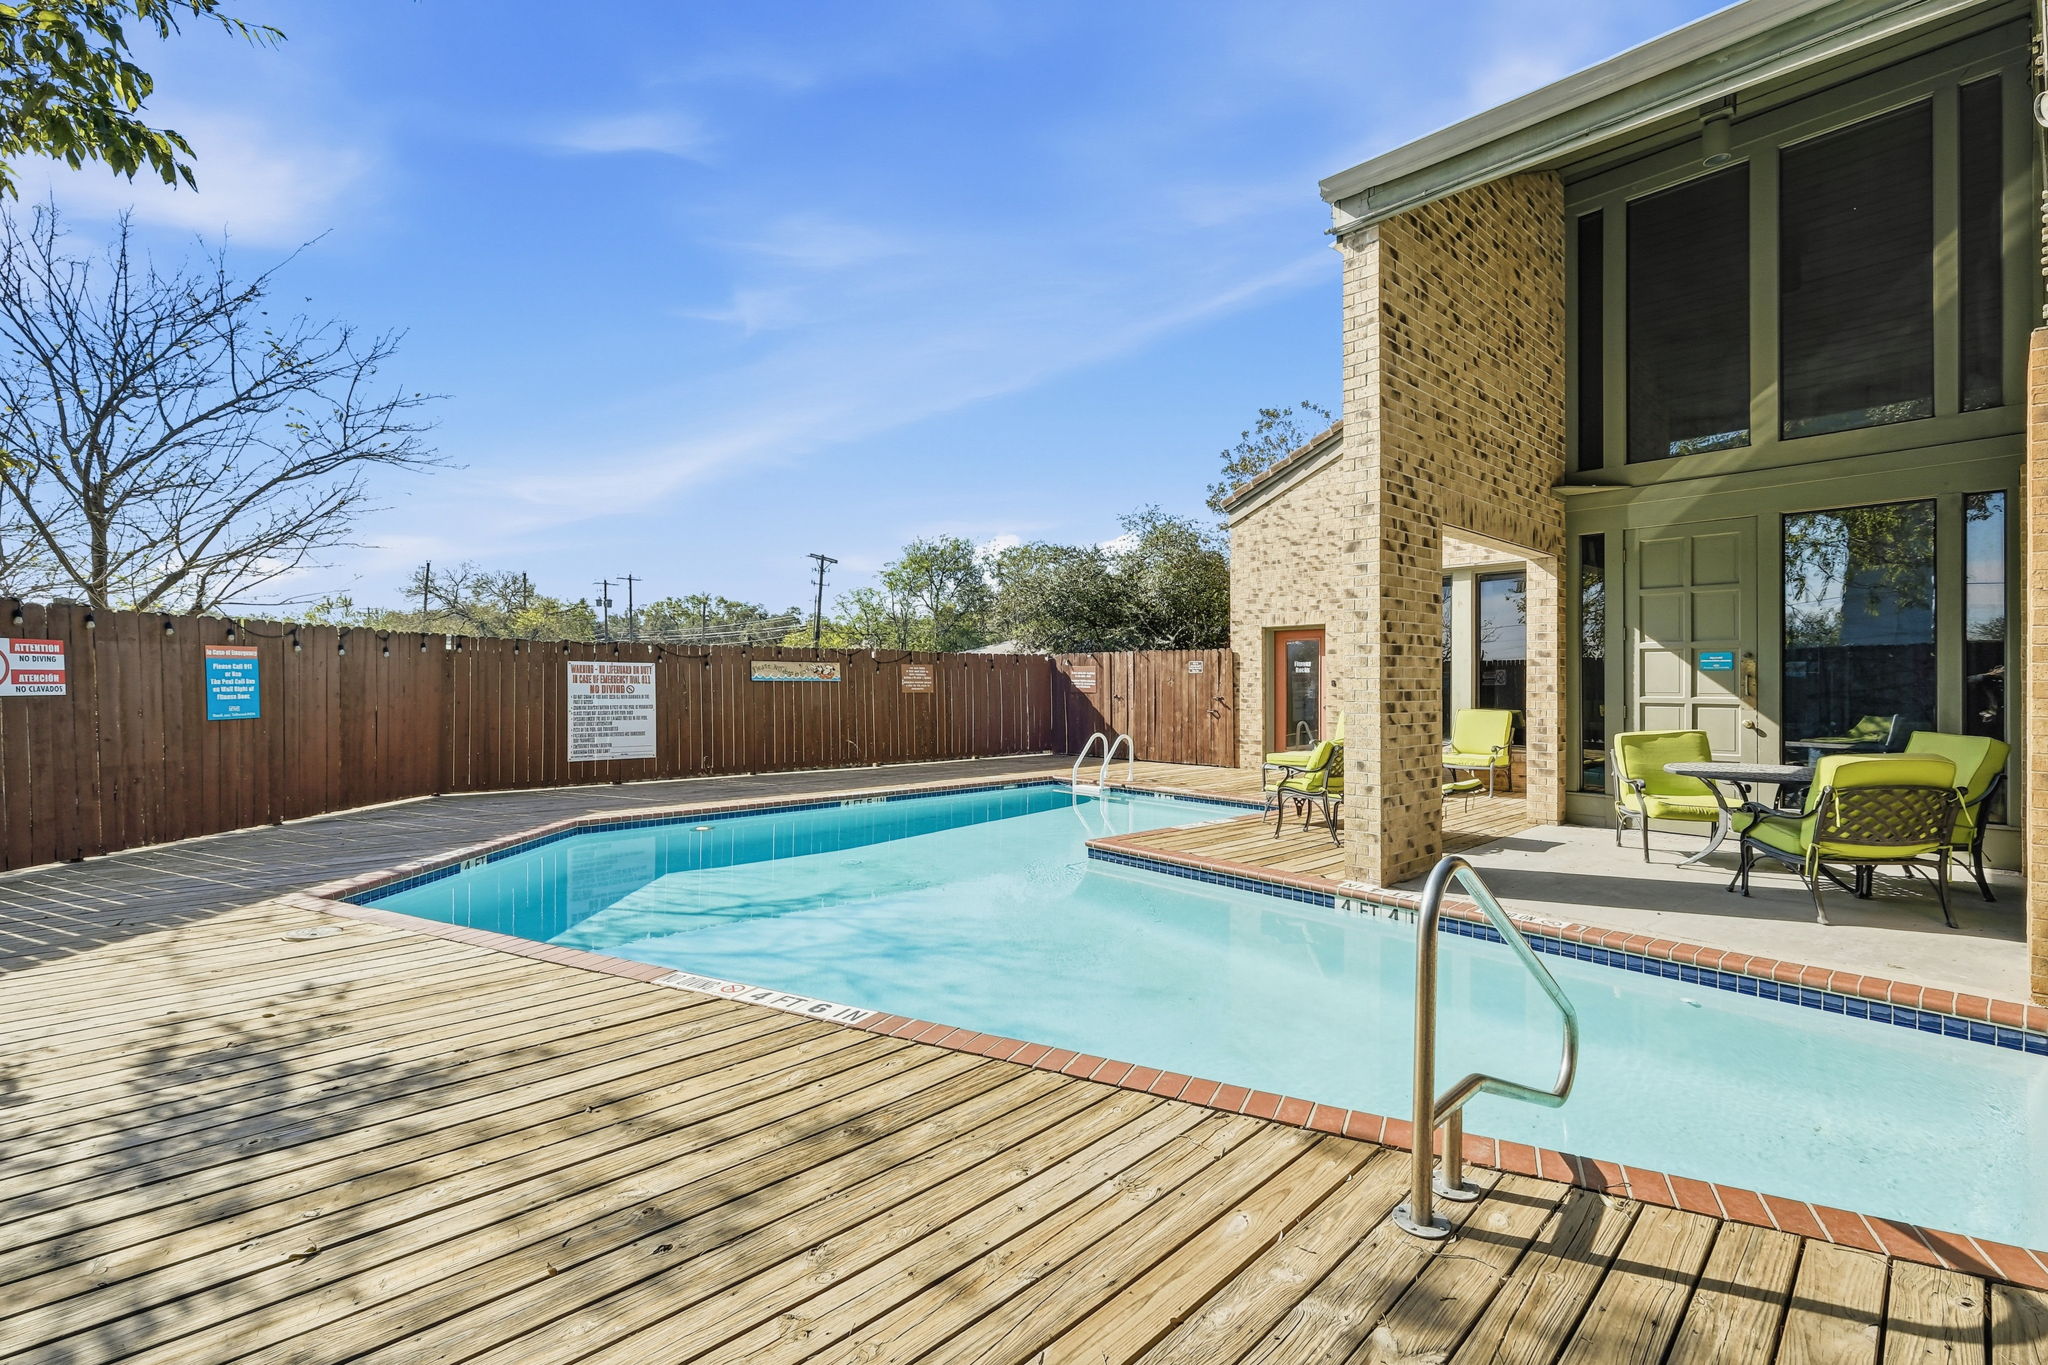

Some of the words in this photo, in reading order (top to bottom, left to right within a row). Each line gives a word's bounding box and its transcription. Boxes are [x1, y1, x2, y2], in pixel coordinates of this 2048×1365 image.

[14, 643, 60, 653] ATTENTION
[32, 655, 57, 663] DIVING
[571, 664, 594, 674] WARNING
[607, 665, 631, 675] LIFEGUARD
[640, 665, 652, 675] DUTY
[18, 673, 60, 683] ATENCIÓN
[579, 674, 592, 684] CASE
[593, 675, 599, 684] OF
[600, 675, 628, 685] EMERGENCY
[28, 685, 63, 693] CLAVADOS
[590, 684, 599, 694] NO
[601, 684, 625, 694] DIVING
[475, 856, 486, 868] FT
[1341, 899, 1351, 911] 4
[1360, 902, 1380, 917] FT
[1388, 908, 1399, 921] 4
[750, 991, 772, 1001] 4
[771, 995, 808, 1008] FT
[807, 1003, 832, 1014] 6
[832, 1008, 869, 1022] IN
